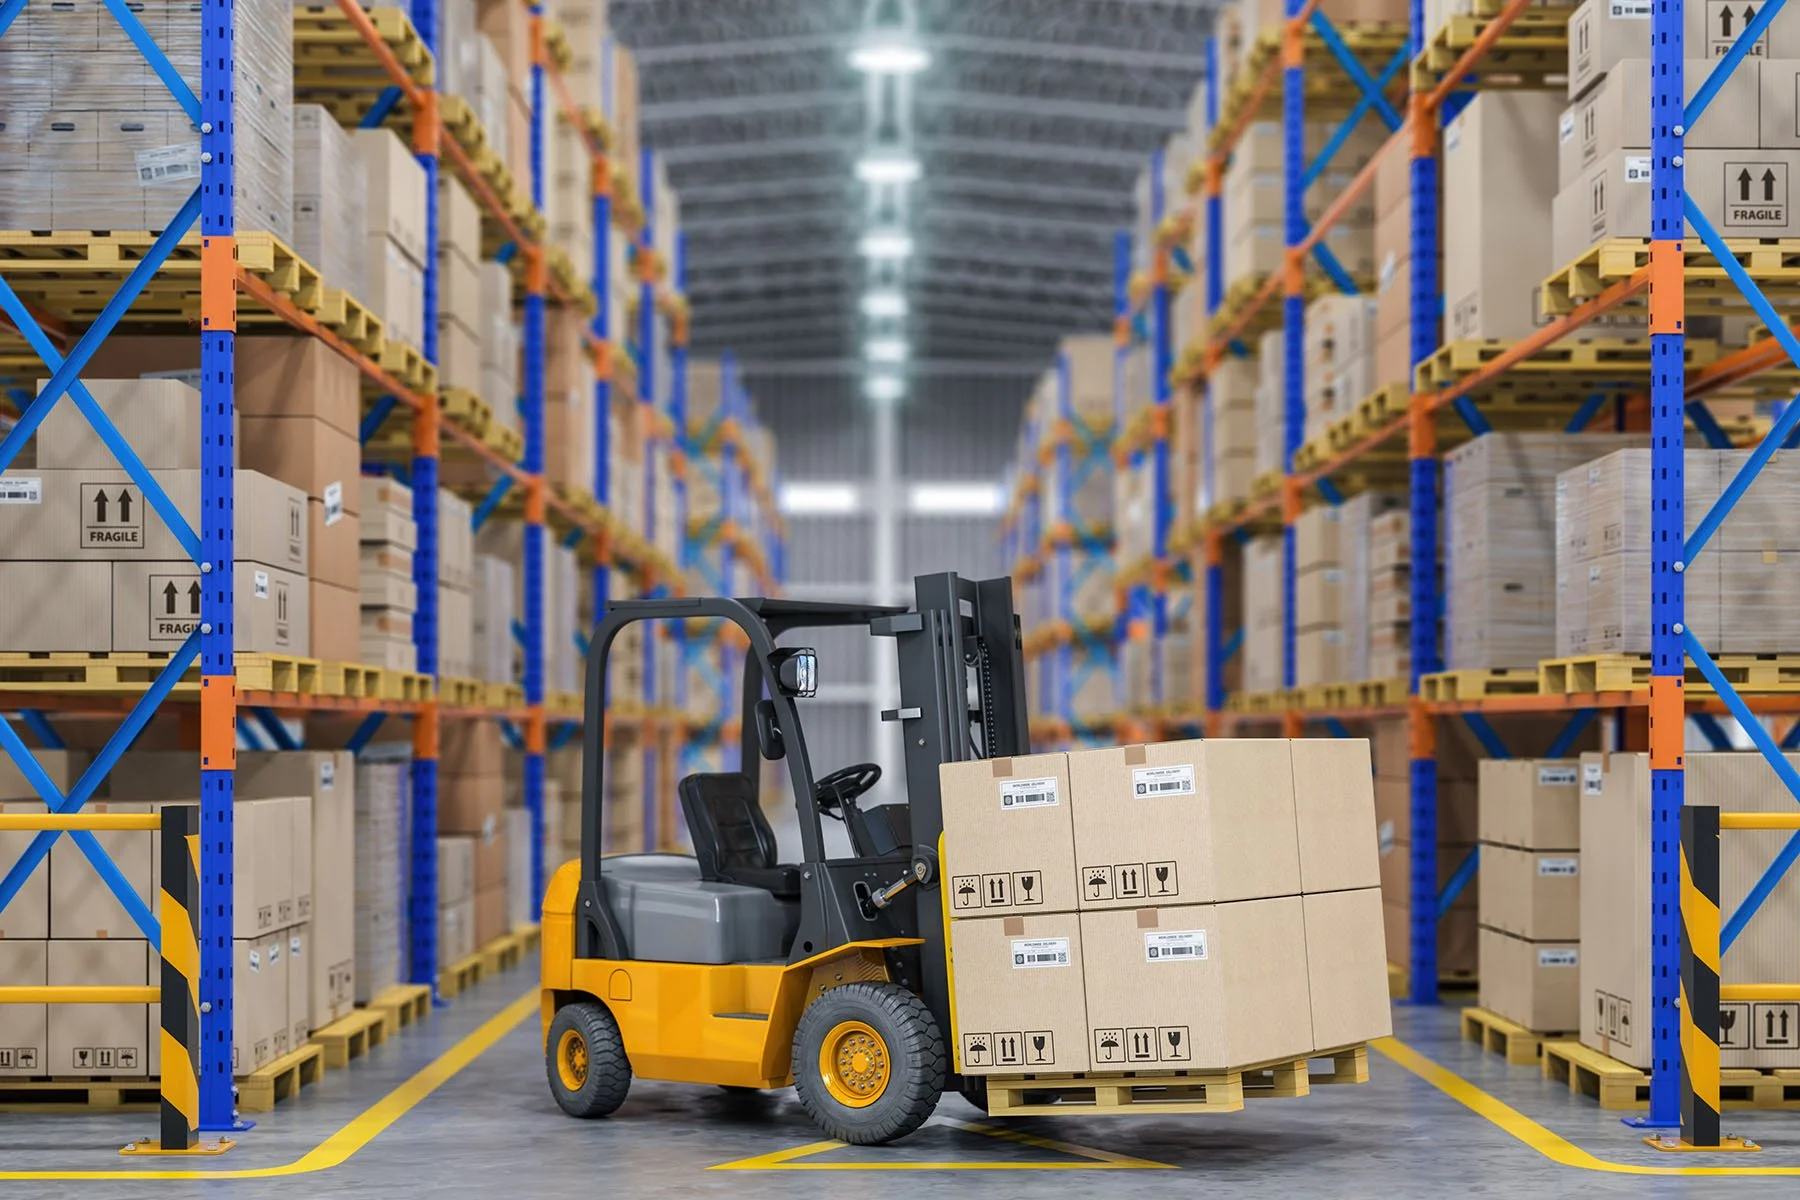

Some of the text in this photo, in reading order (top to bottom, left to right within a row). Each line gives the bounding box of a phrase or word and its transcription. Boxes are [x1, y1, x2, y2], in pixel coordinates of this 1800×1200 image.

[1715, 45, 1762, 56] FRLE
[1733, 209, 1781, 220] FRAGILE
[90, 531, 138, 542] FRAGILE
[159, 623, 199, 634] FRAGI
